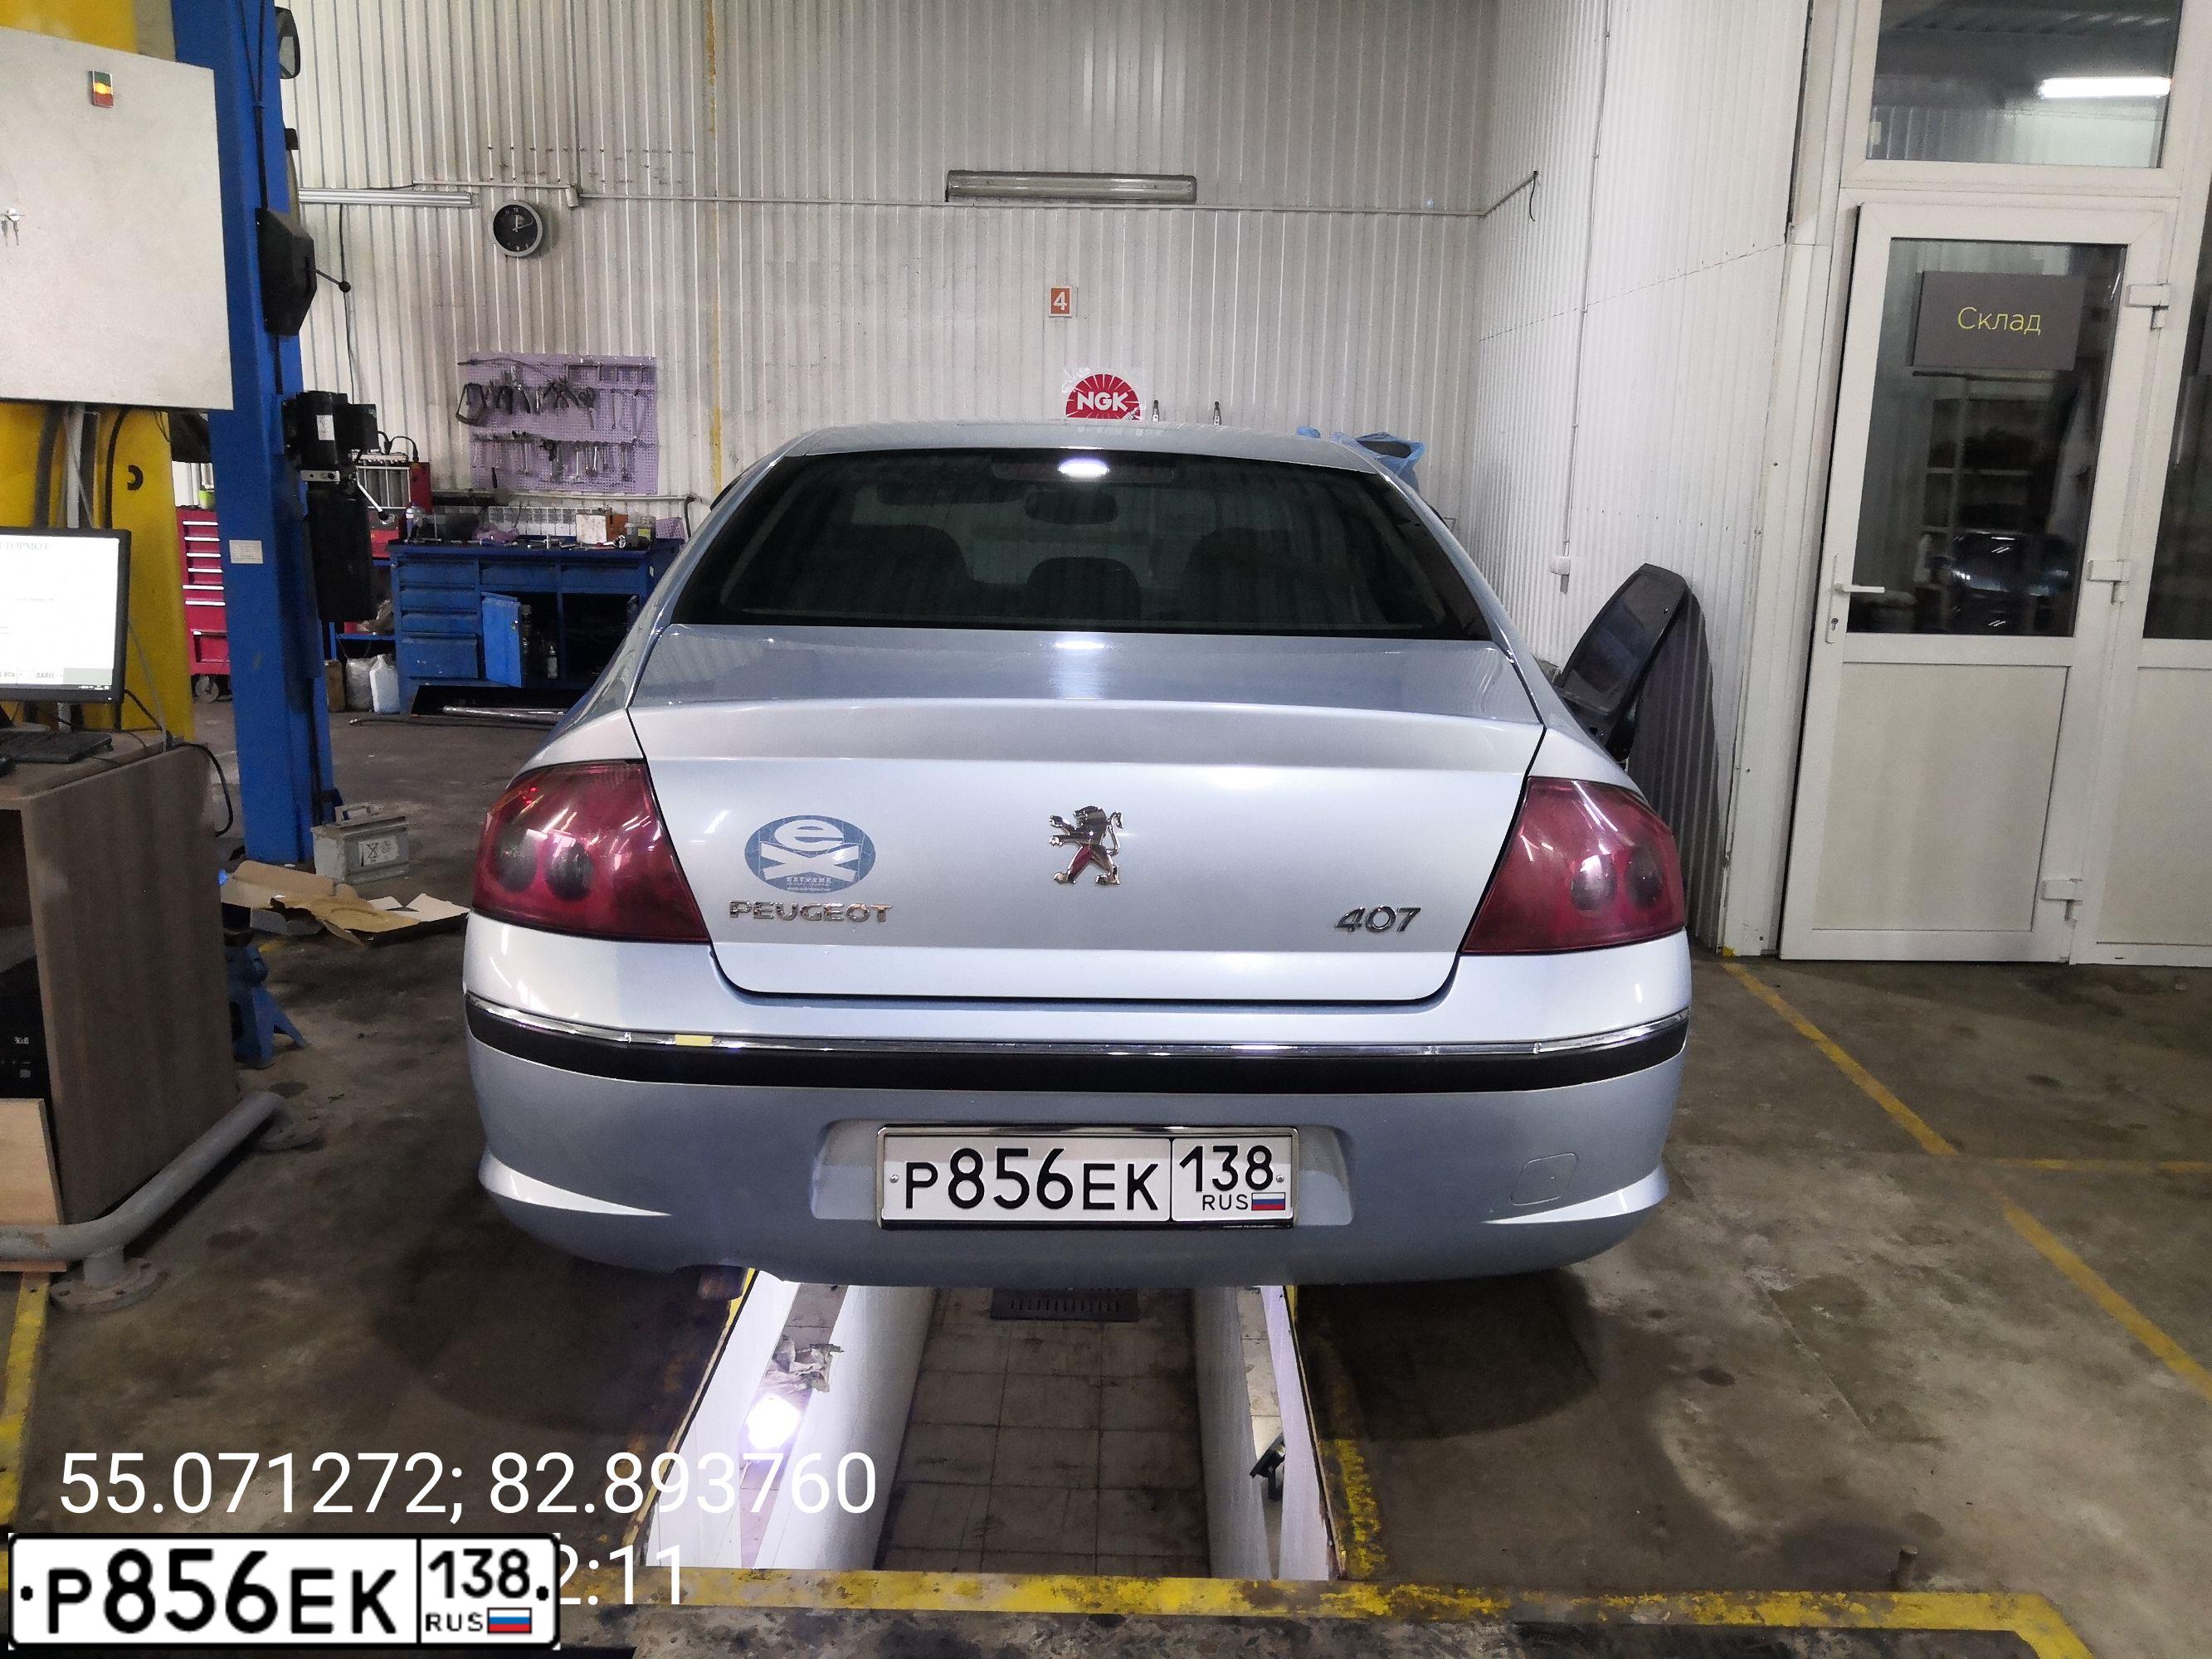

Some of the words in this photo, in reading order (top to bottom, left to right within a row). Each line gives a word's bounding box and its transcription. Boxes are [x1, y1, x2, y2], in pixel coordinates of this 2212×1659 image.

[1053, 291, 1068, 311] 4
[1957, 306, 2041, 336] Склад
[1077, 392, 1128, 411] NGK
[729, 900, 892, 923] PEUGEOT
[1334, 906, 1421, 933] 407
[1179, 1145, 1274, 1192] 138
[1202, 1194, 1249, 1211] RUS
